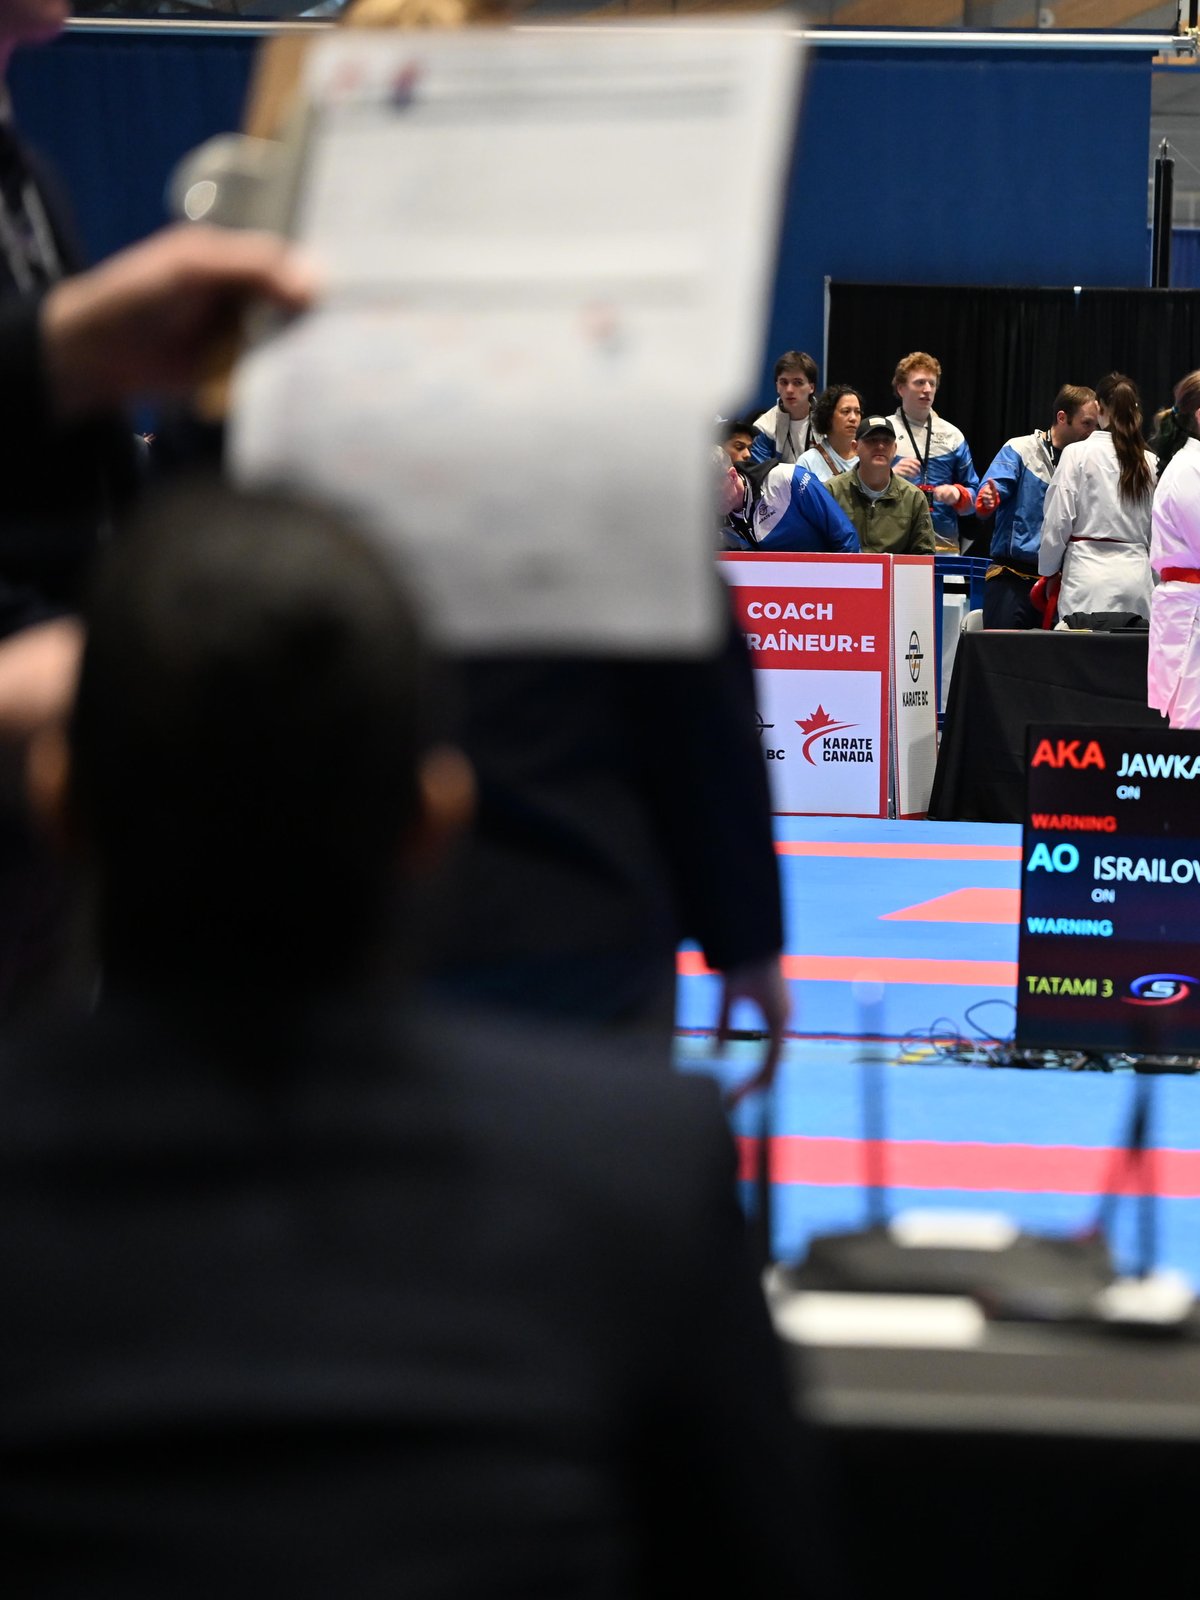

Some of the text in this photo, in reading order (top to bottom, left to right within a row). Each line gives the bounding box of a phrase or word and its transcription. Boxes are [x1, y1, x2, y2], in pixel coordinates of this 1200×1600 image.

[747, 602, 833, 620] COACH
[743, 629, 875, 652] RAÎNEUR·E
[902, 690, 929, 707] KARATE BC
[823, 738, 872, 750] KARATE
[766, 749, 785, 760] BC
[823, 750, 873, 763] CANADA
[1031, 739, 1106, 769] AKA
[1116, 785, 1141, 800] ON
[1031, 813, 1117, 833] WARNING
[1027, 843, 1079, 873] AO
[1091, 888, 1116, 903] ON
[1027, 917, 1114, 937] WARNING
[1026, 976, 1113, 998] TATAMI 3
